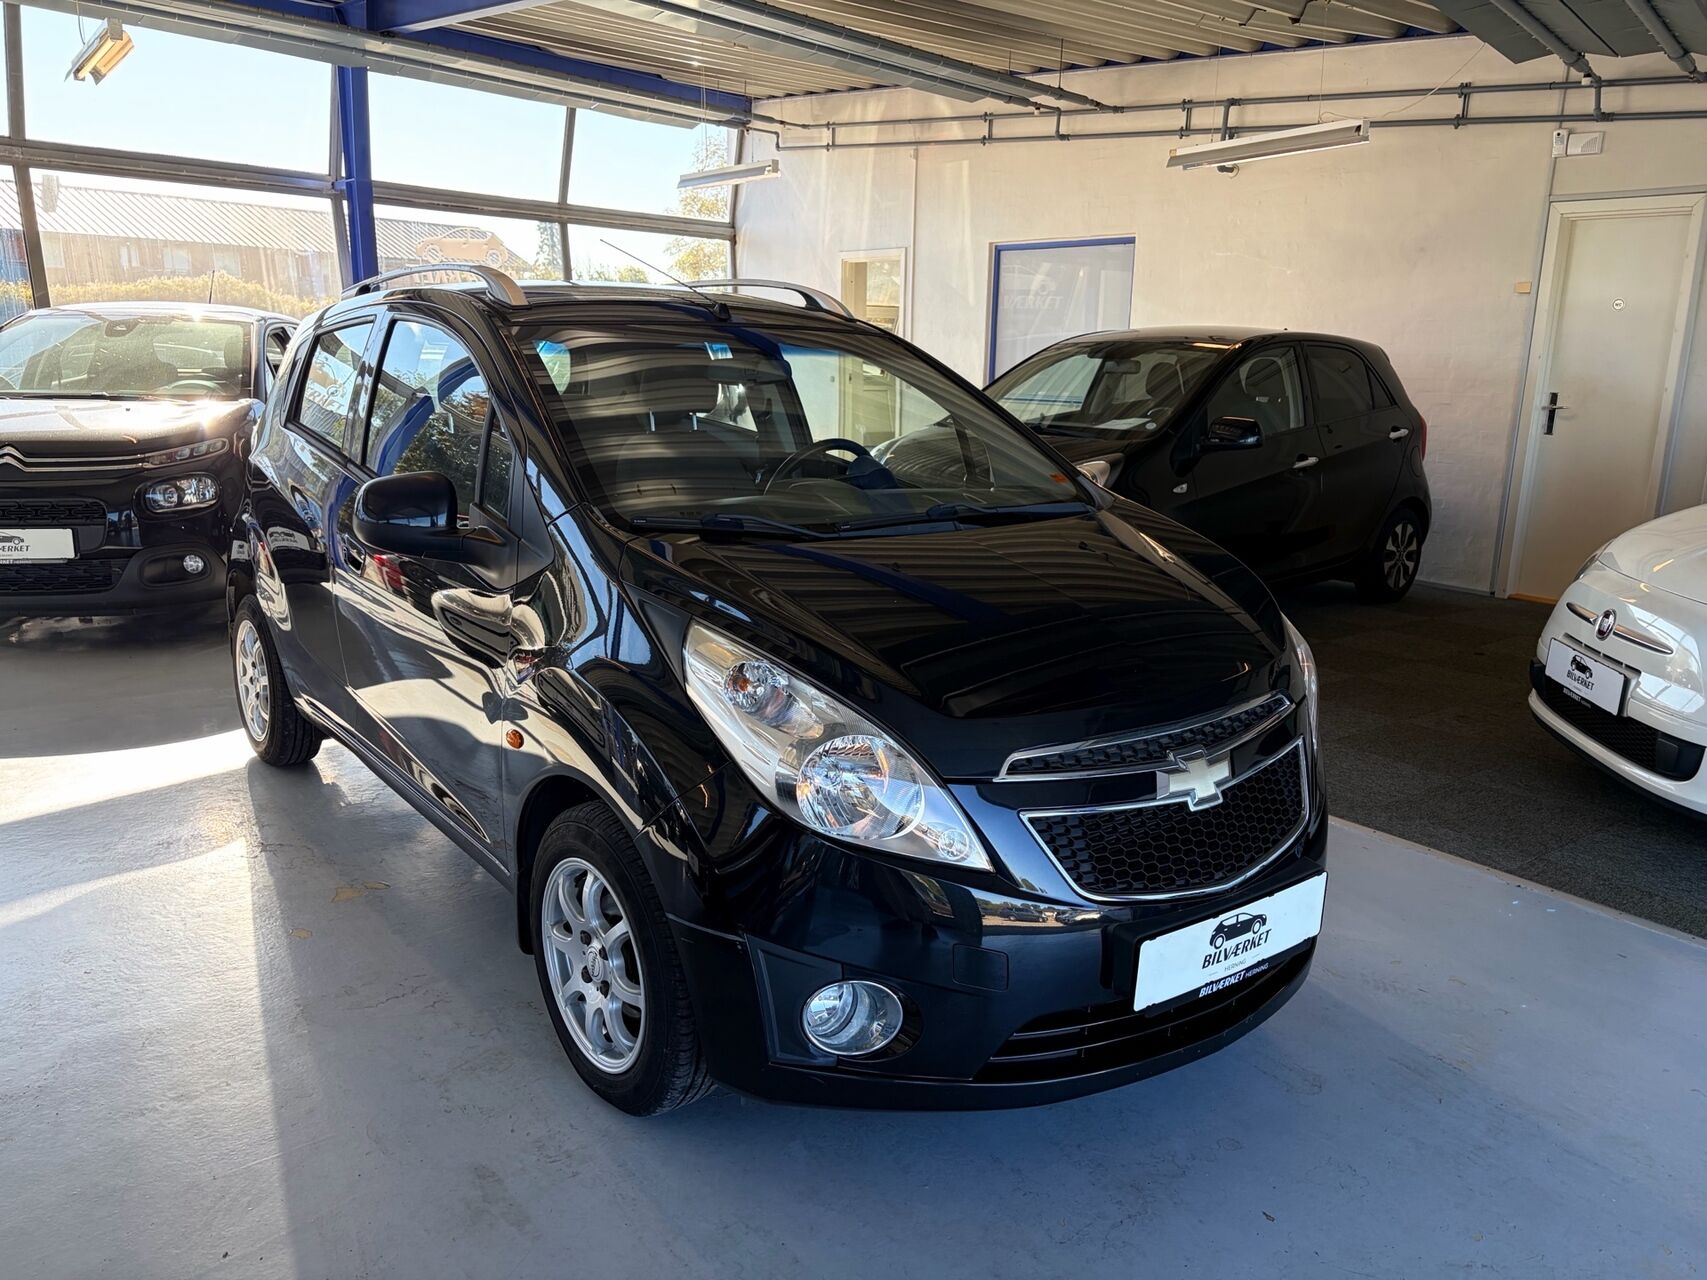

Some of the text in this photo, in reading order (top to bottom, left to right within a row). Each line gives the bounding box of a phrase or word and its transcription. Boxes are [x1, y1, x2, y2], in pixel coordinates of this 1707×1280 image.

[1202, 928, 1273, 969] BILVÆRKET
[1225, 957, 1247, 973] HERNING
[1199, 962, 1269, 998] BILVÆRKET HERNING
